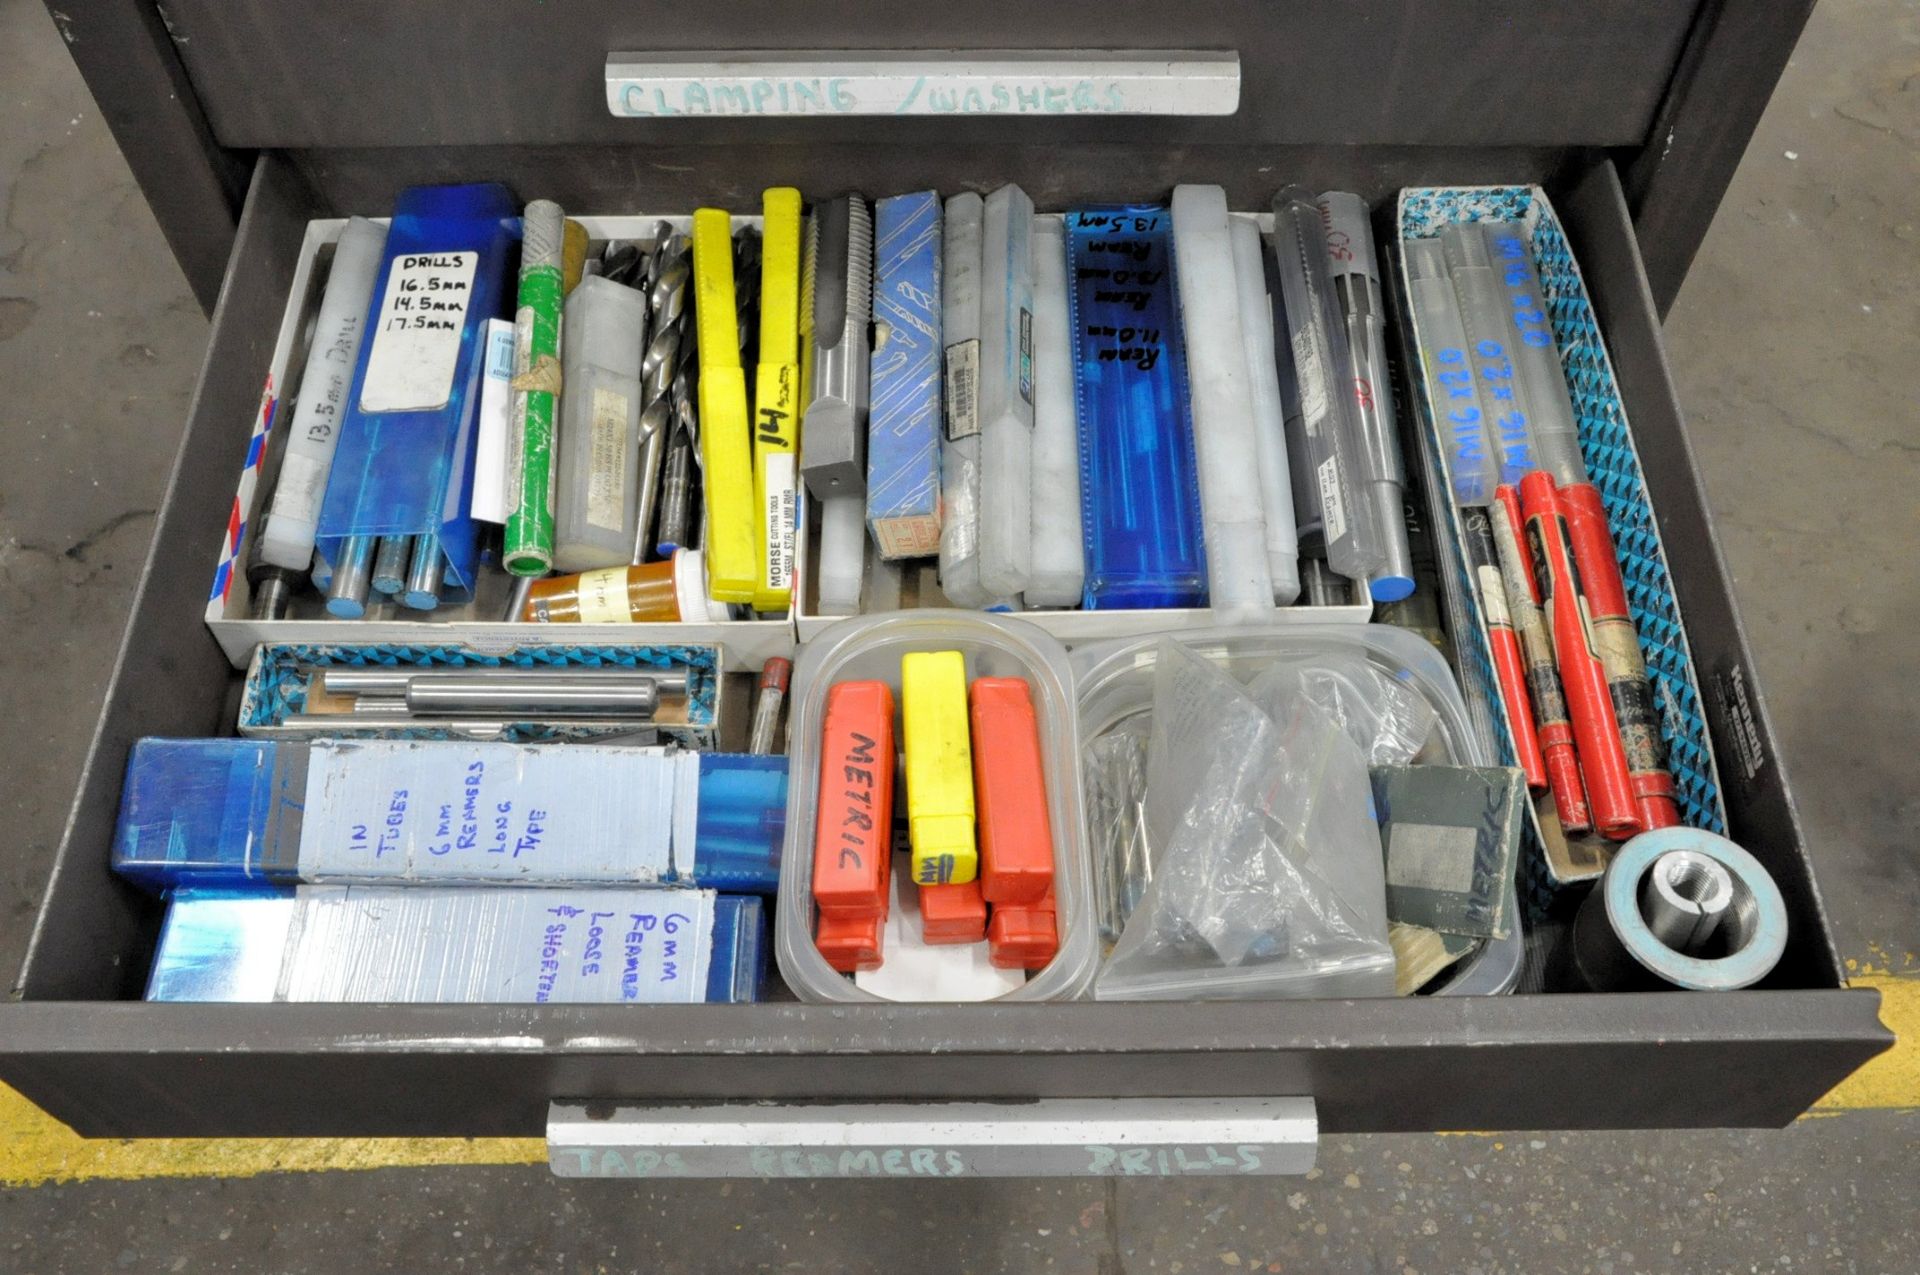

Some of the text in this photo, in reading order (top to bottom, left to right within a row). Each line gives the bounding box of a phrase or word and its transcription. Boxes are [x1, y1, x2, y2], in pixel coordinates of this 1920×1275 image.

[619, 78, 857, 116] CLAMPING
[400, 277, 466, 292] 16.5mm
[403, 256, 463, 270] DRILLS
[386, 316, 455, 331] 17.5mm
[394, 296, 463, 311] 14.5mm
[758, 407, 789, 448] 14
[770, 495, 781, 587] MORSE CUTTING TOOLS
[1731, 664, 1764, 770] Kennedy
[376, 790, 409, 858] TUBES
[456, 761, 484, 850] REAMERS
[838, 732, 876, 869] METRIC
[349, 825, 367, 850] IN
[487, 801, 511, 854] LONG
[513, 810, 546, 858] TYPE
[1465, 786, 1508, 921] METRIC
[582, 912, 615, 977] LOOSE
[557, 1147, 688, 1175] TAPS
[1084, 1145, 1265, 1178] DRILLS
